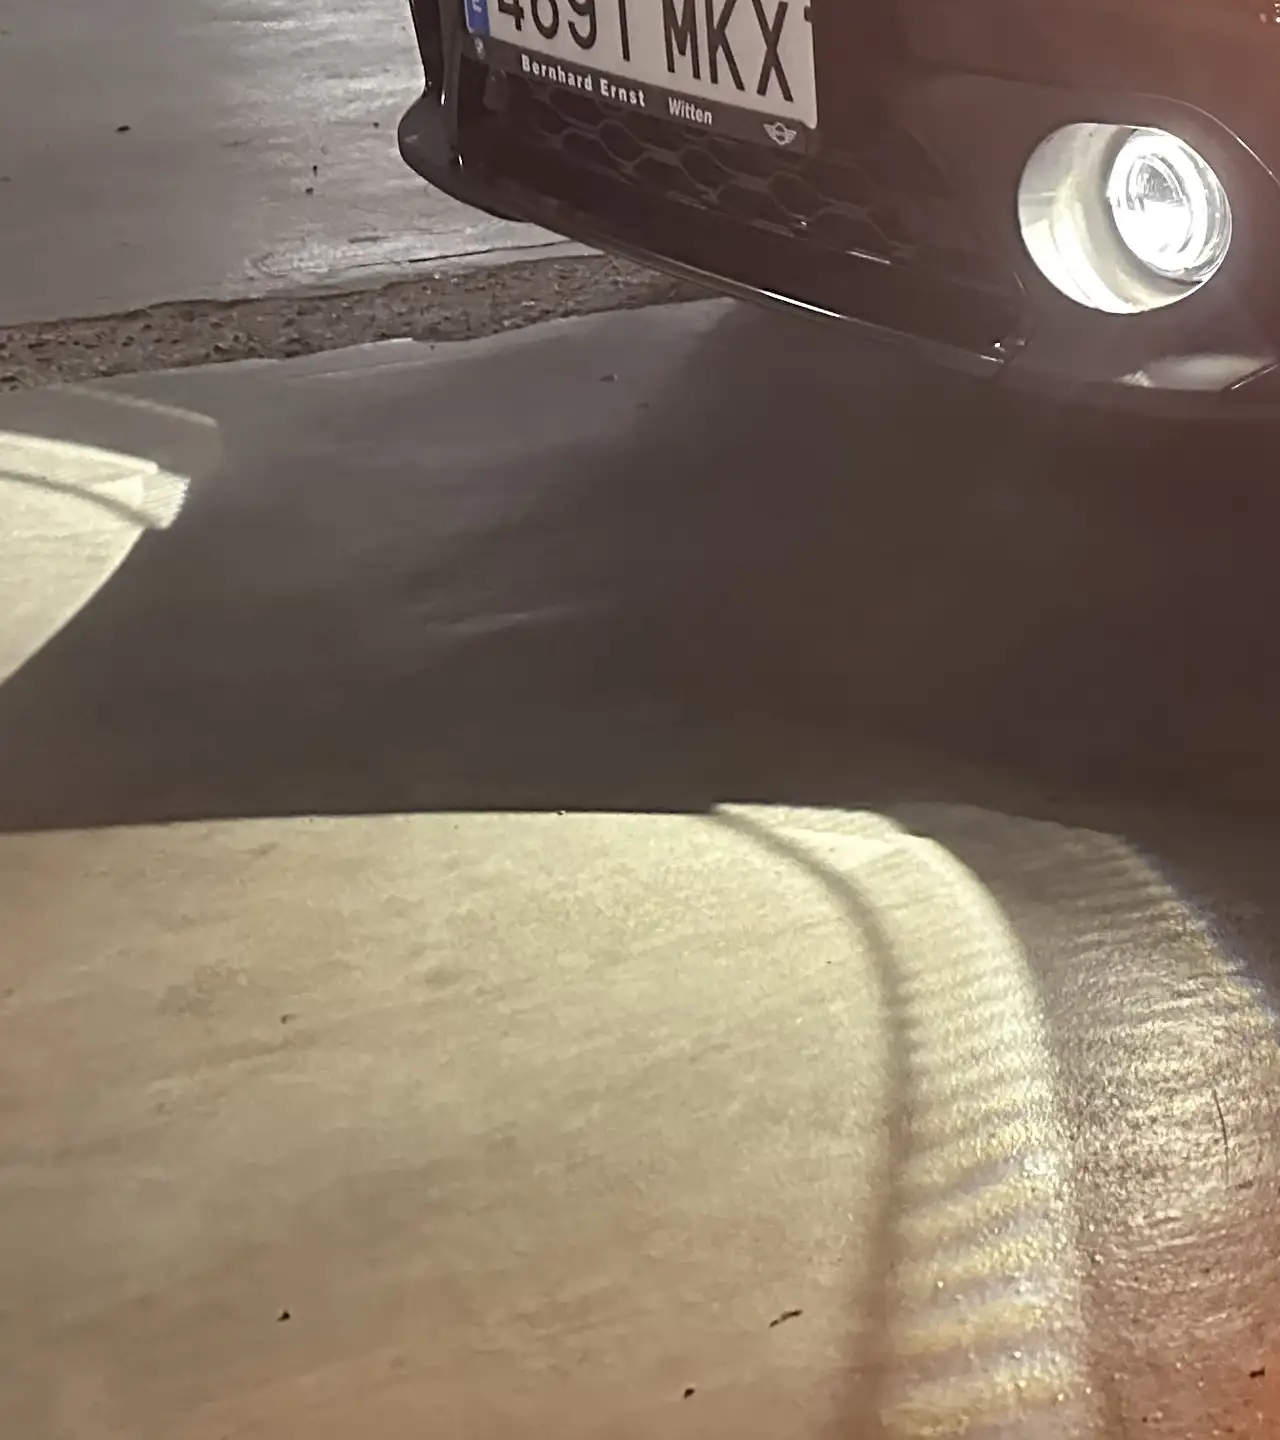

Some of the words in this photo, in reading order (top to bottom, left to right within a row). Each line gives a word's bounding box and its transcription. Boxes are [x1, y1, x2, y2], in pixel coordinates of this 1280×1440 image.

[521, 54, 594, 92] Bernhard
[599, 79, 646, 108] Ernst
[668, 96, 713, 127] Witten
